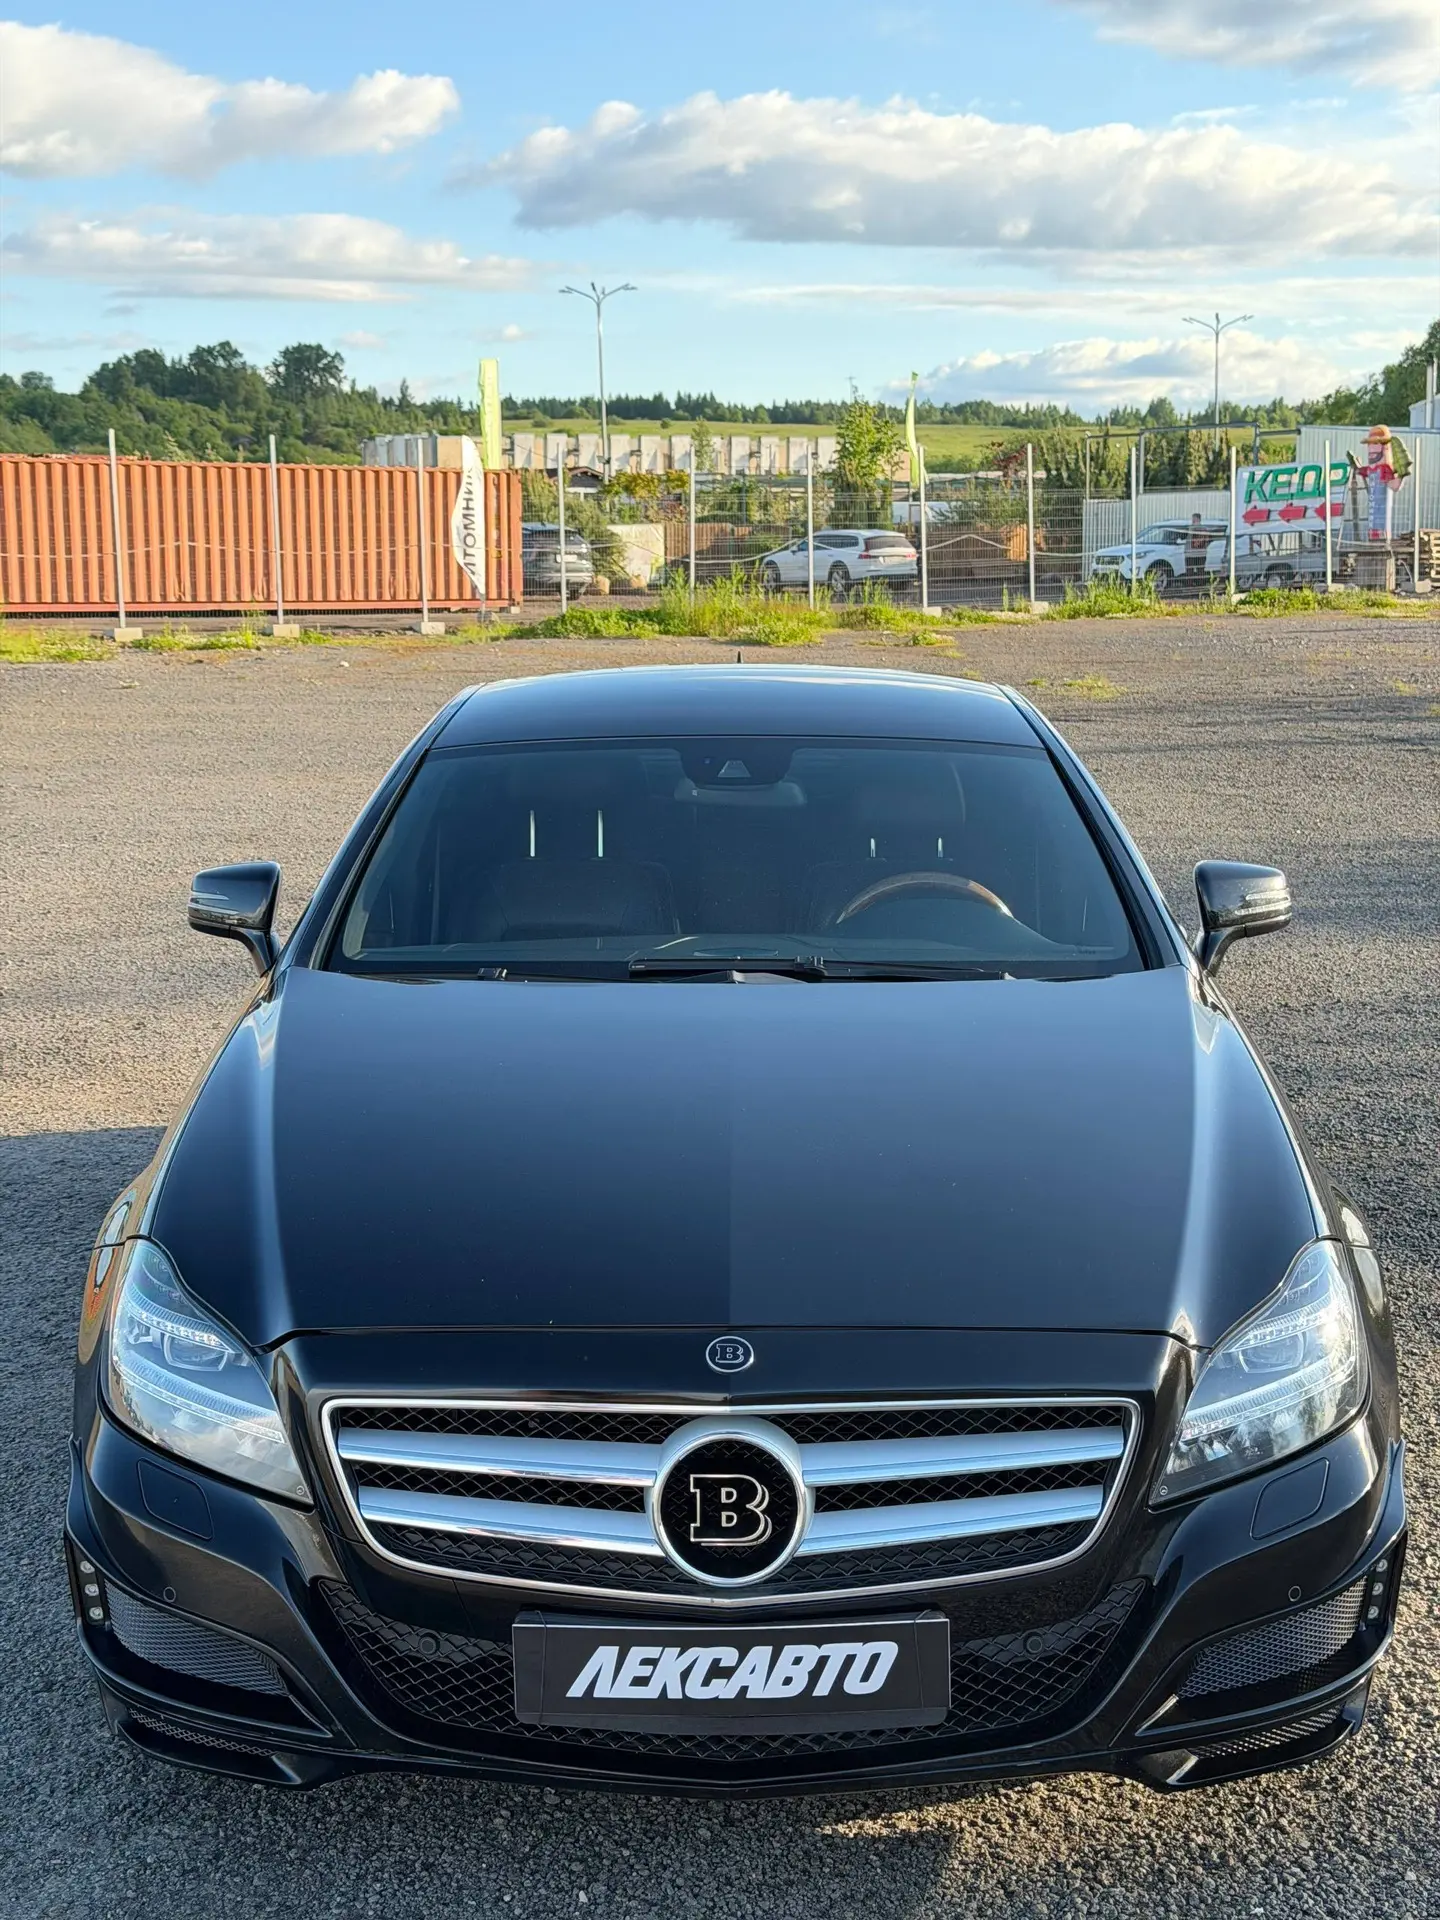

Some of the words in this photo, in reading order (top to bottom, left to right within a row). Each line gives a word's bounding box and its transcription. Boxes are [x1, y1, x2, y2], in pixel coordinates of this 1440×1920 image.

[715, 1343, 744, 1363] B
[690, 1474, 773, 1547] B
[565, 1641, 899, 1700] ЛЕКСАВТО
